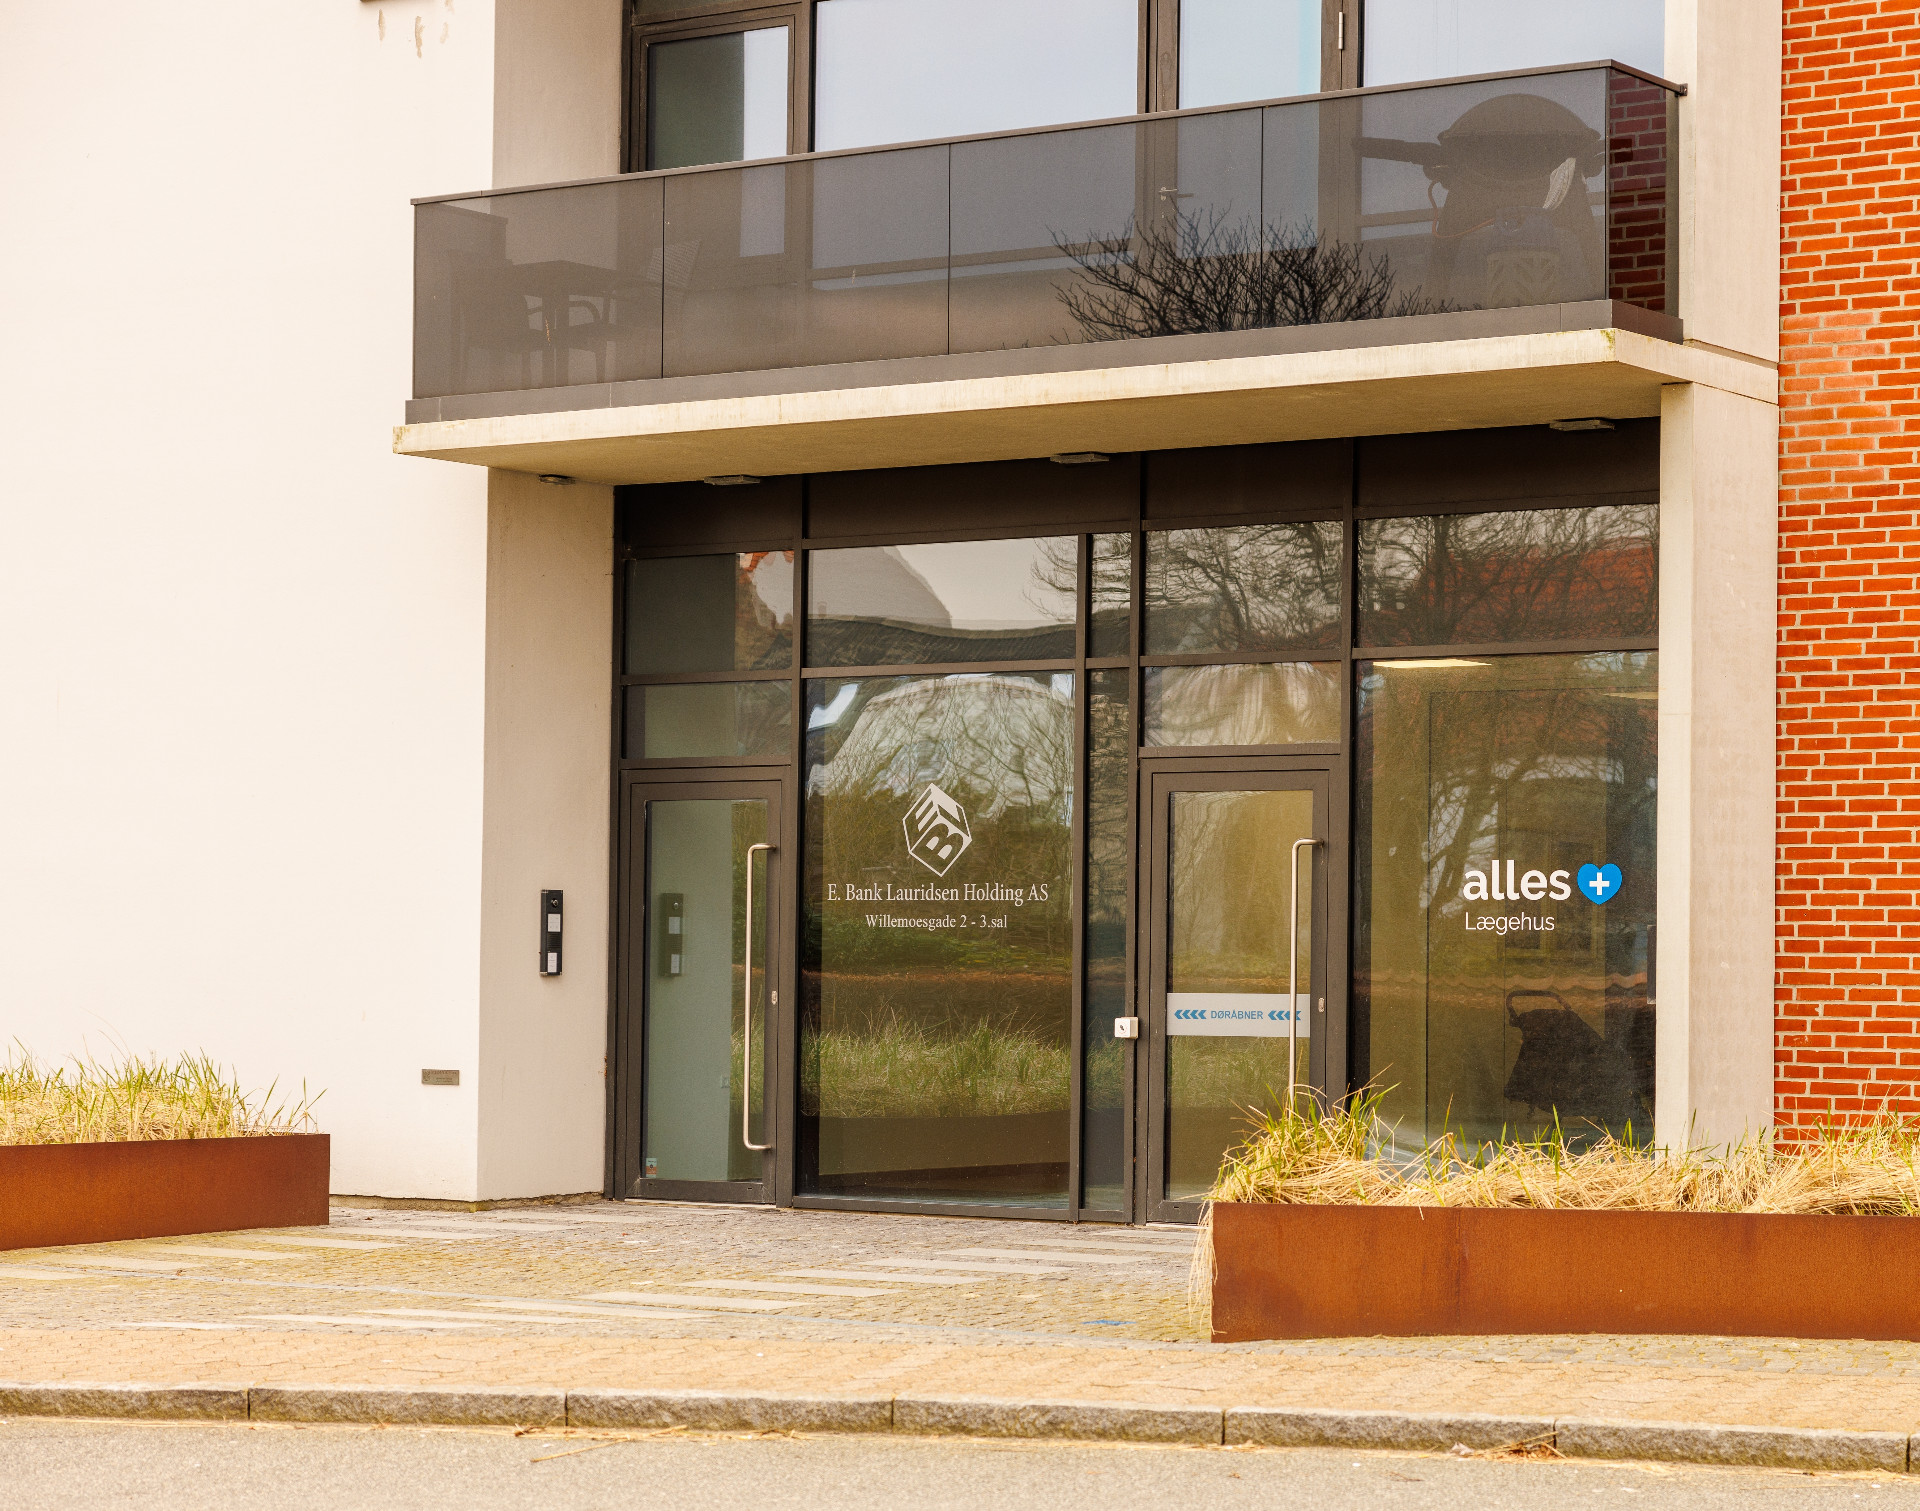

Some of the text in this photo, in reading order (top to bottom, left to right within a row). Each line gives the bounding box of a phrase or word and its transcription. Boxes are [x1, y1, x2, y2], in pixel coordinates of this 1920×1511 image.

[1462, 859, 1572, 901] alles
[827, 882, 1049, 907] E. Bank Lauridsen Holding AS
[865, 914, 957, 932] Willemoesgade
[959, 914, 967, 928] 2
[979, 914, 1008, 929] 3.sal
[1465, 911, 1555, 936] Lægehus
[1210, 1009, 1264, 1020] DØRÅBNER
